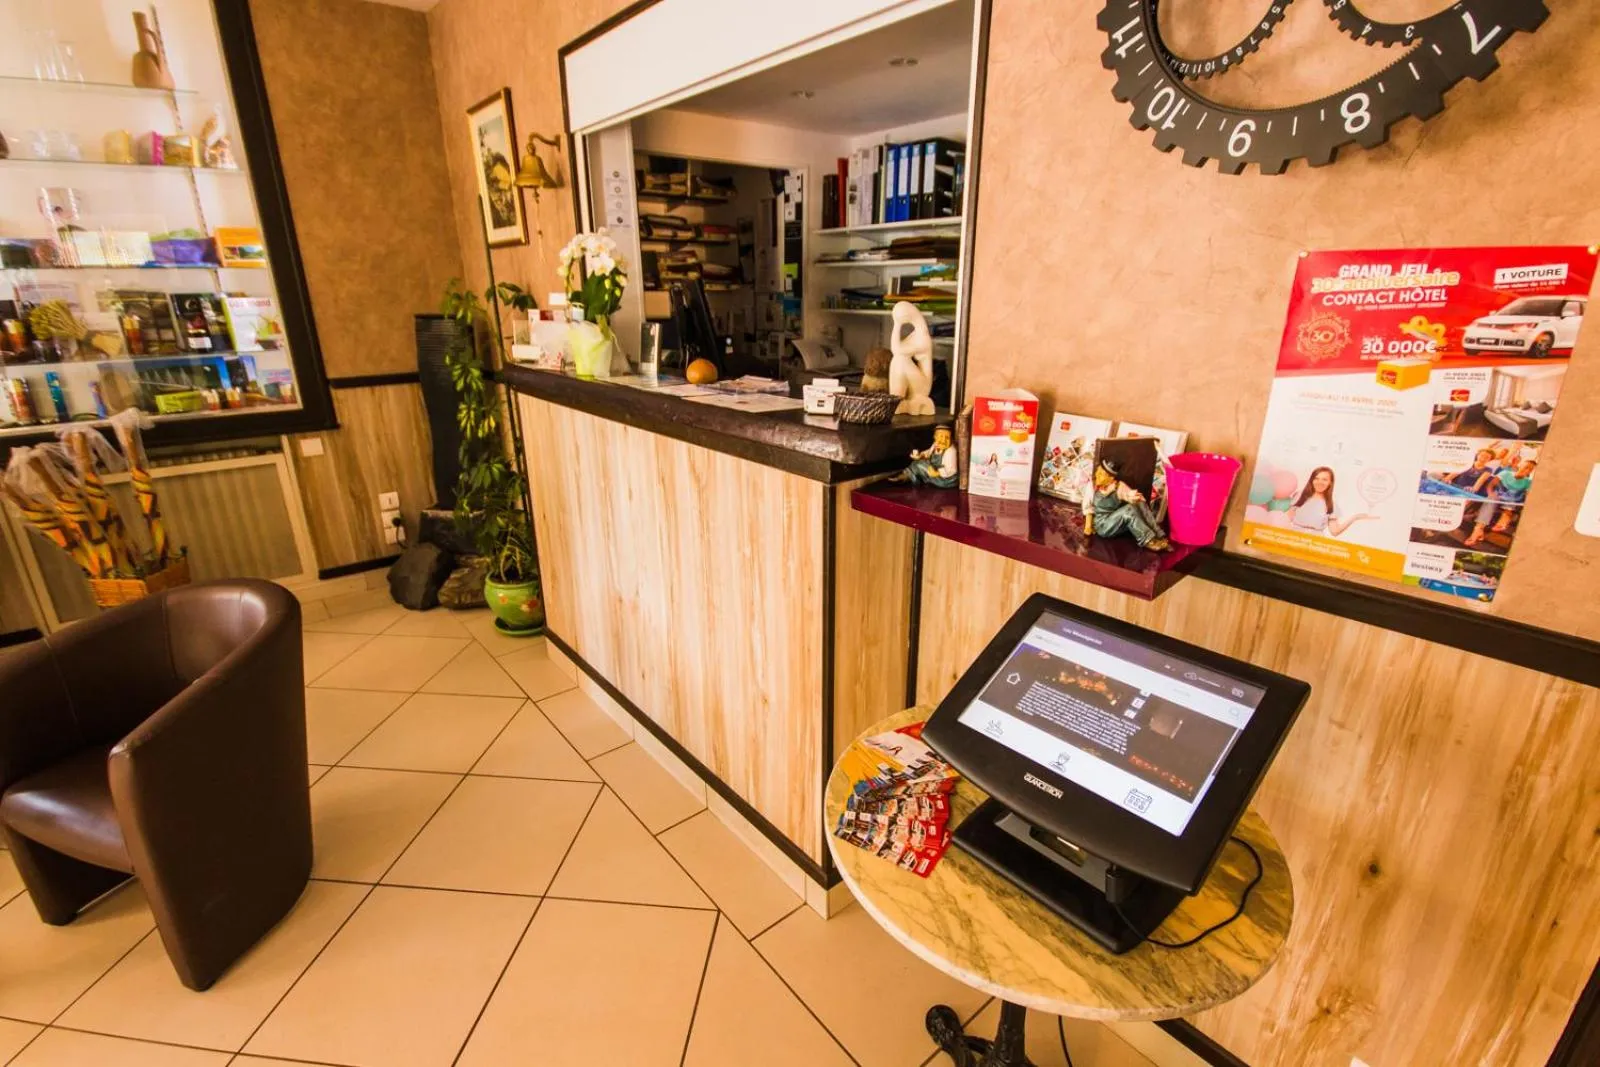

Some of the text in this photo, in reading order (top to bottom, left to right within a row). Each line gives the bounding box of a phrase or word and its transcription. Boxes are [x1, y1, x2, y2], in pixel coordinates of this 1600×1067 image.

[1271, 5, 1281, 15] 5
[1261, 21, 1270, 31] 6
[1361, 22, 1372, 36] 4
[1405, 25, 1415, 39] 3
[1112, 16, 1144, 59] 11
[1249, 36, 1258, 45] 7
[1461, 11, 1502, 56] 7
[1235, 46, 1244, 57] 8
[1204, 60, 1216, 72] 10
[1222, 55, 1229, 65] 9
[1179, 62, 1190, 74] 12
[1192, 63, 1203, 74] 11
[1147, 86, 1186, 130] 10
[1340, 92, 1371, 134] 8
[1228, 119, 1256, 157] 9
[1338, 263, 1430, 279] GRAND JEU
[1511, 268, 1562, 279] VOITURE
[1338, 268, 1461, 291] anniversaire
[1322, 290, 1396, 307] CONTACT
[1399, 287, 1449, 303] HÔTEL
[1360, 340, 1437, 355] 30 000€
